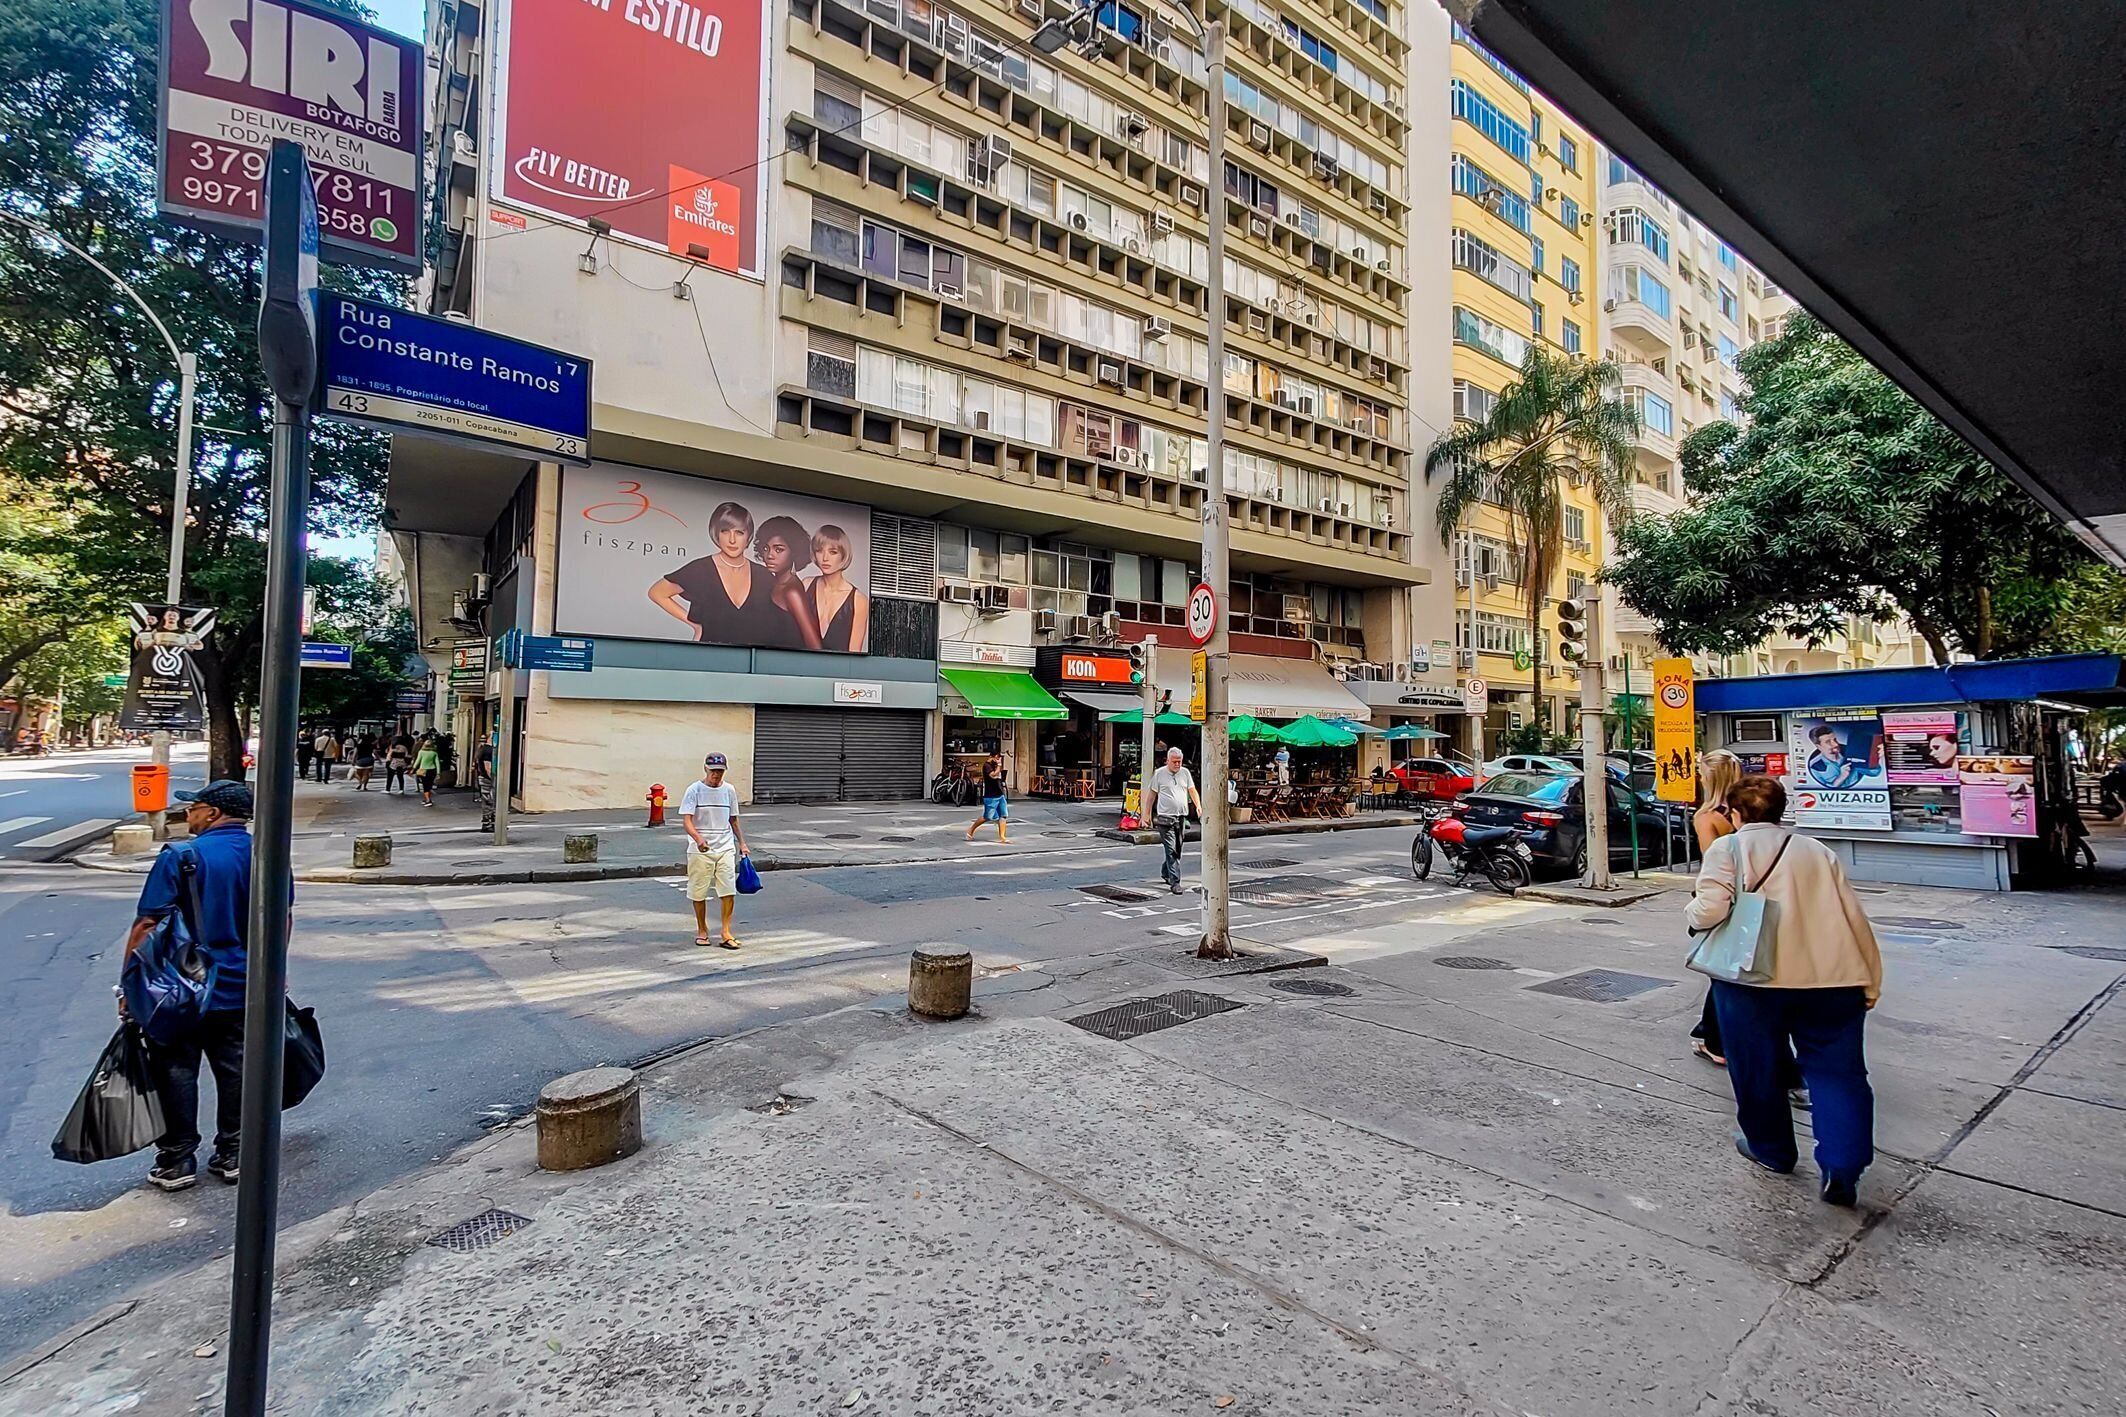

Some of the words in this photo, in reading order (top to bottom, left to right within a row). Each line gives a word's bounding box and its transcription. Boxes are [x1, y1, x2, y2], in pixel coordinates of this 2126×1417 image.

[624, 0, 723, 58] ESTILO
[189, 0, 400, 130] SIRI
[306, 103, 401, 144] BOTAFOGO
[382, 90, 396, 126] BARRA
[230, 107, 331, 143] DELIVERY
[335, 135, 364, 154] EM
[217, 122, 272, 145] TODA
[338, 153, 376, 176] SUL
[527, 146, 562, 178] FLY
[564, 159, 631, 200] BETTER
[674, 204, 736, 236] Emirates
[339, 300, 391, 330] Rua
[338, 325, 474, 371] Constante
[482, 356, 561, 393] Ramos
[336, 374, 359, 386] 1831
[396, 385, 451, 404] Proprietário
[453, 397, 465, 407] do
[467, 399, 491, 412] local.
[338, 394, 369, 413] 43
[416, 410, 460, 425] 22051-011
[465, 420, 518, 437] Copacabana
[555, 437, 578, 455] 23
[582, 530, 688, 558] fiszpan
[1192, 595, 1211, 622] 30
[1656, 674, 1690, 687] ZONA
[1667, 687, 1686, 701] 30
[1254, 706, 1277, 718] BAKERY
[1818, 792, 1886, 804] WIZARD
